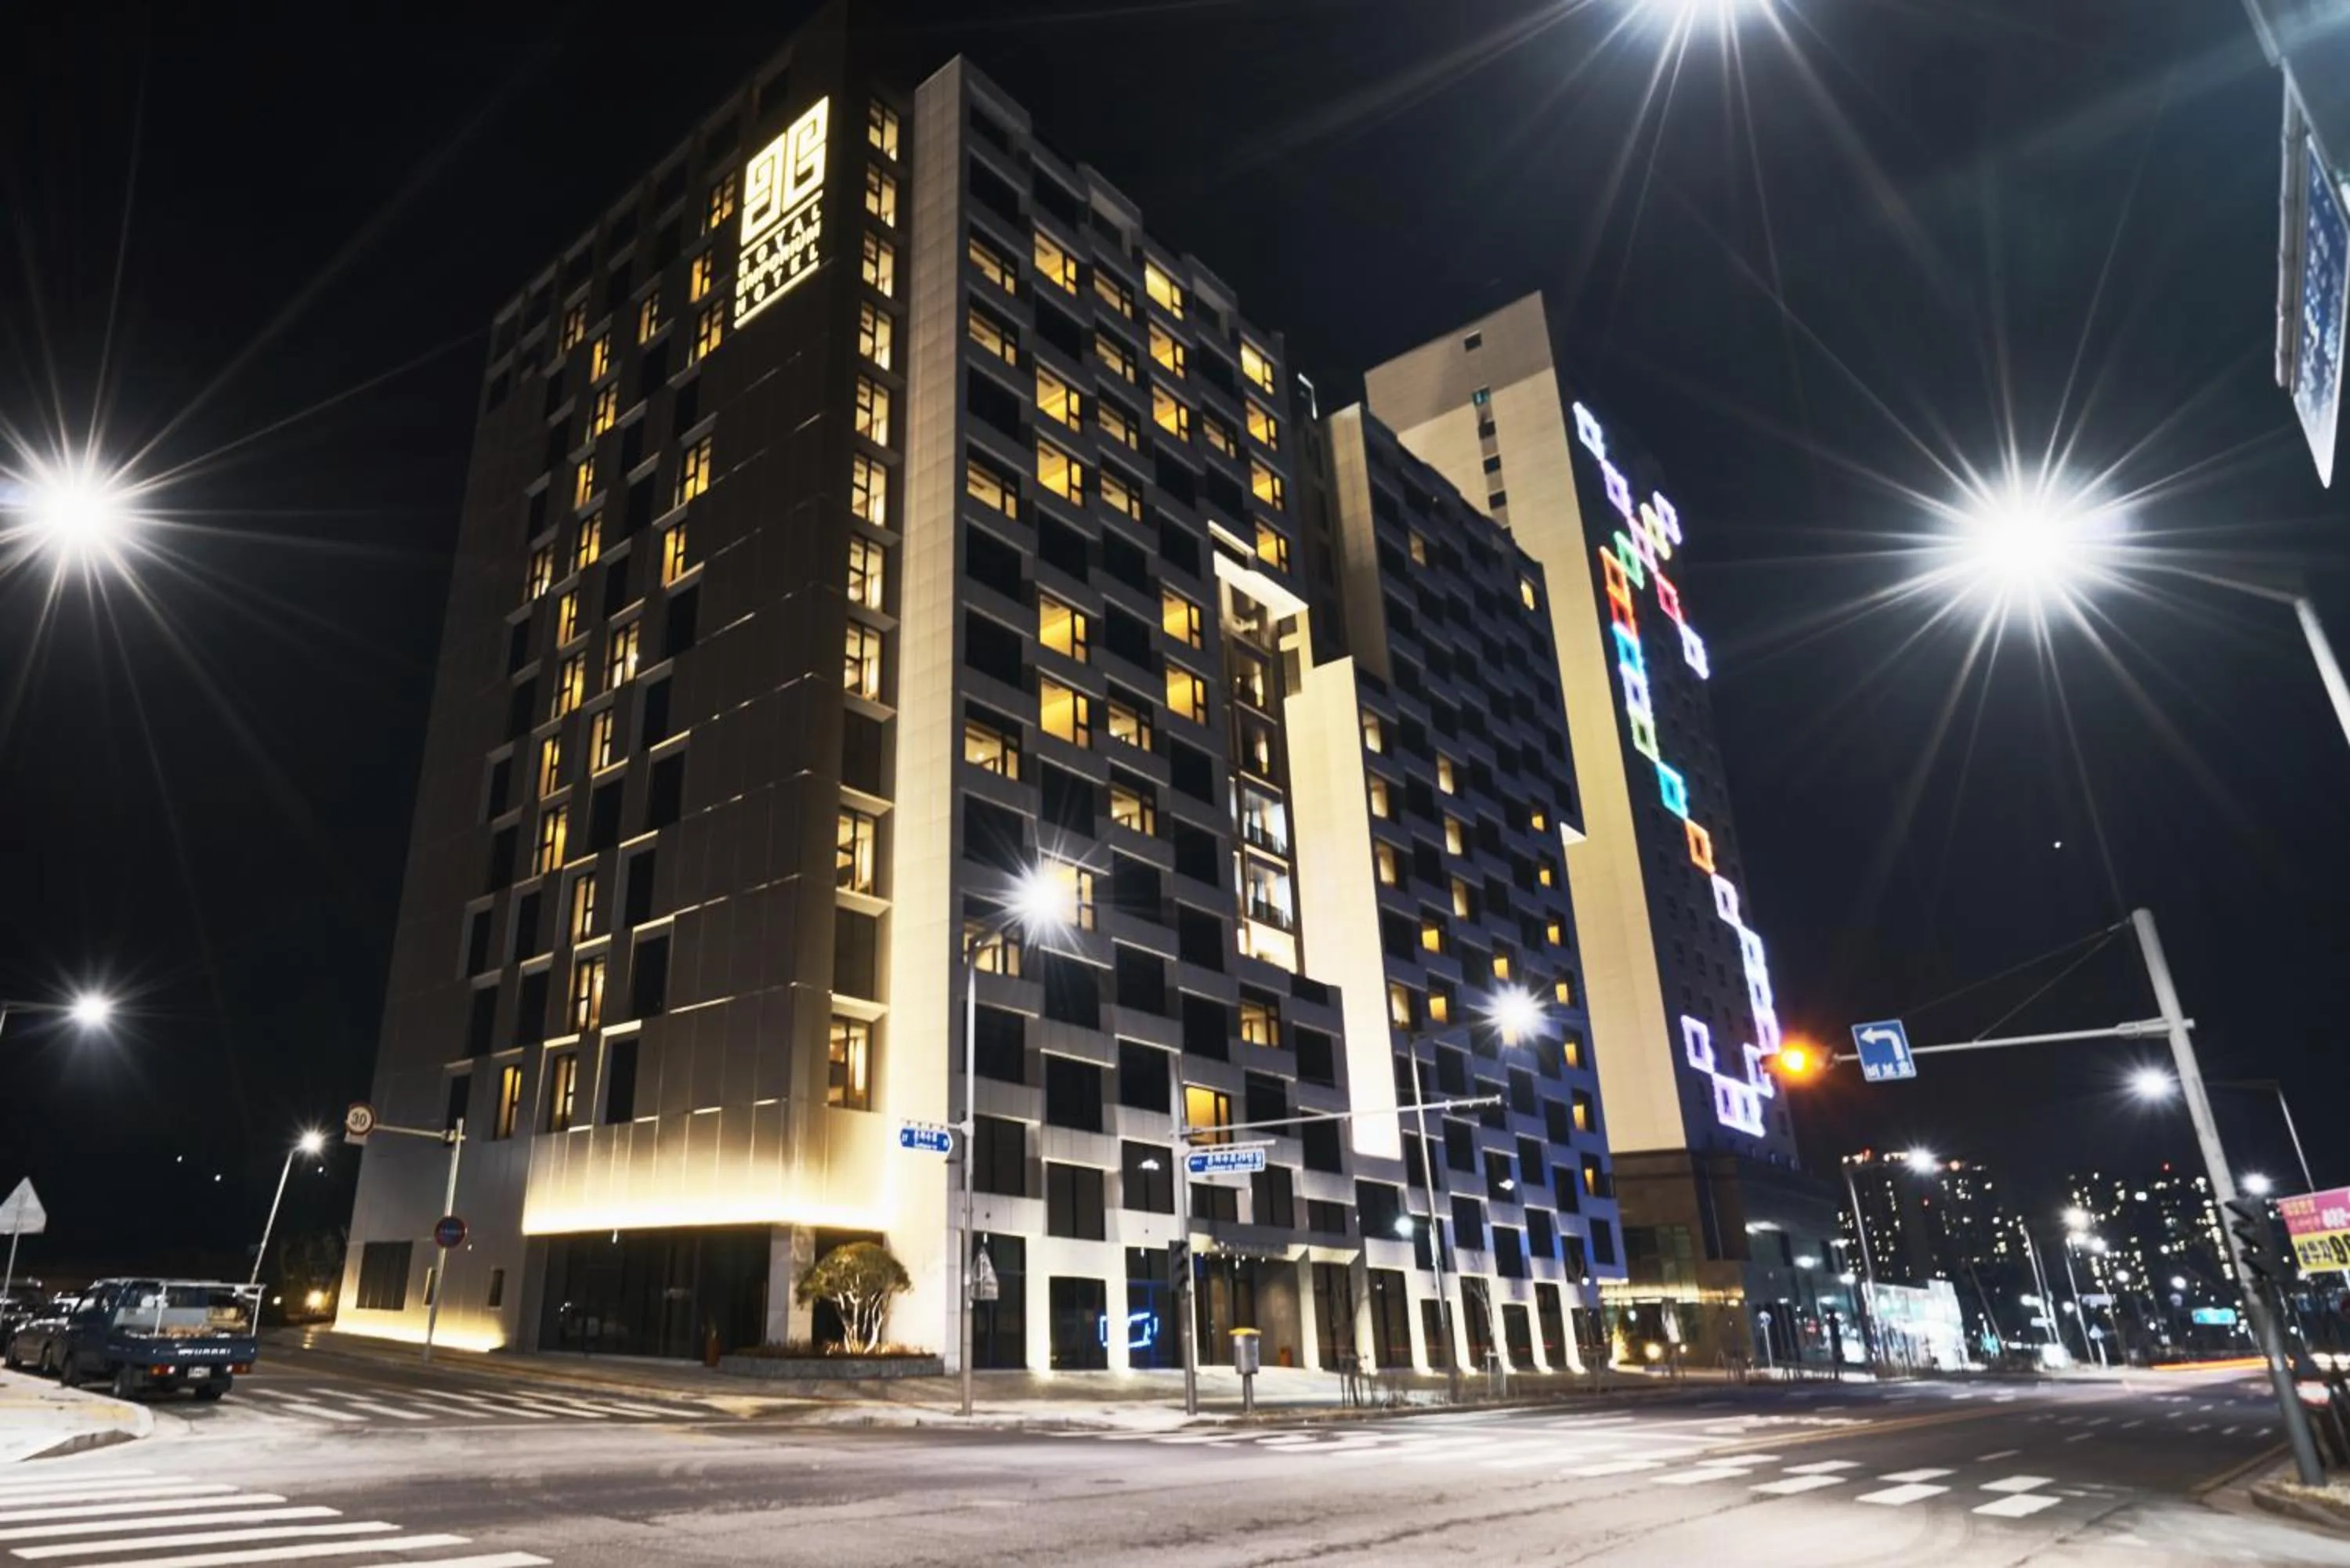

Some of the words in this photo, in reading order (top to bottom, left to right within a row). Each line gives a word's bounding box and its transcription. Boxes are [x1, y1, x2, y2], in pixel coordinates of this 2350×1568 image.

[736, 220, 821, 298] EMPORIUM
[738, 204, 822, 279] ROYAL
[735, 243, 819, 318] HOTEL
[351, 1111, 367, 1126] 30
